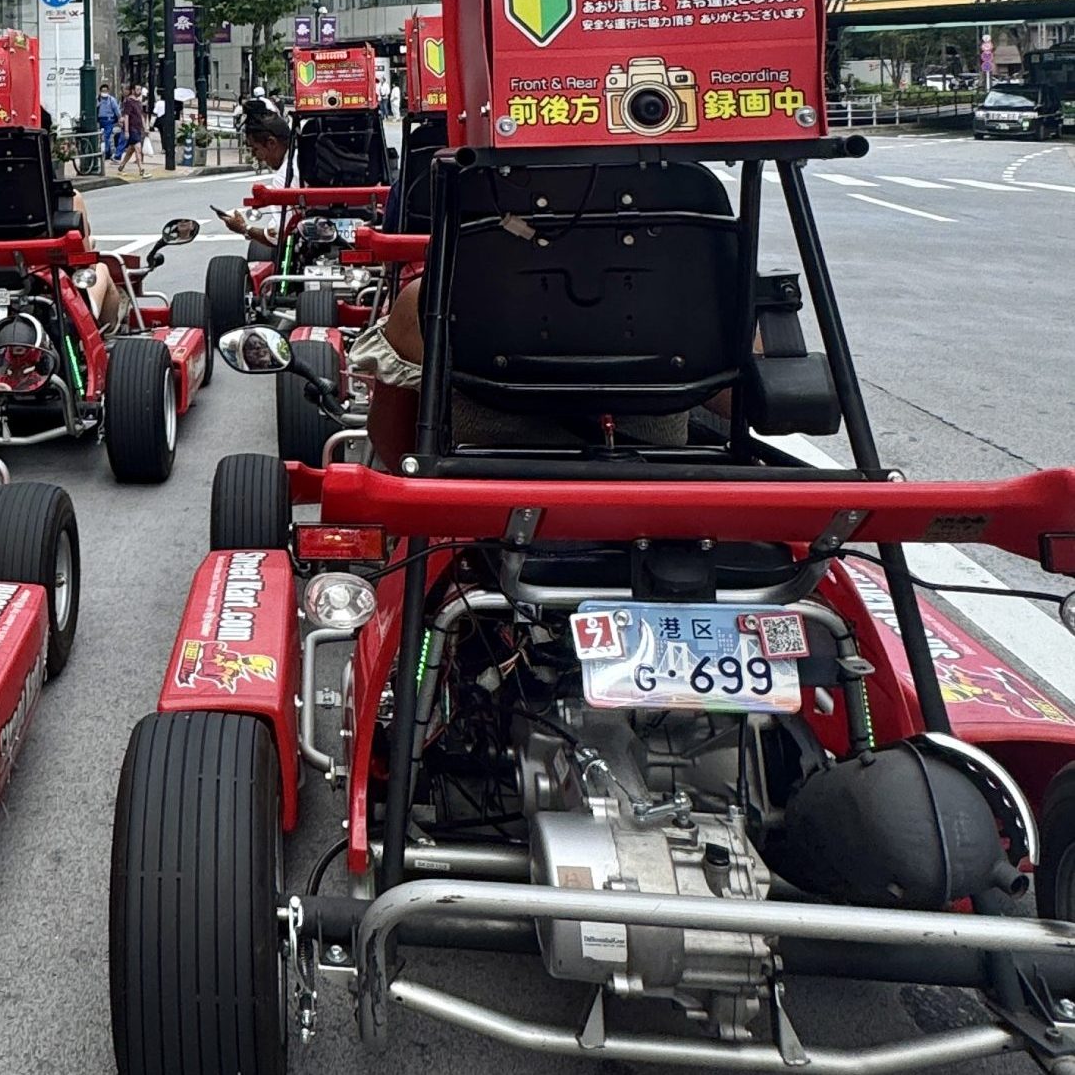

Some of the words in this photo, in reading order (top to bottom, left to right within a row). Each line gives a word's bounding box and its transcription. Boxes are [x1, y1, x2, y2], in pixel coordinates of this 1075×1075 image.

[510, 78, 546, 91] Front
[550, 77, 562, 90] &
[566, 76, 599, 90] Rear
[710, 68, 791, 86] Recording
[507, 95, 600, 127] 前後方
[703, 87, 806, 120] 録画中
